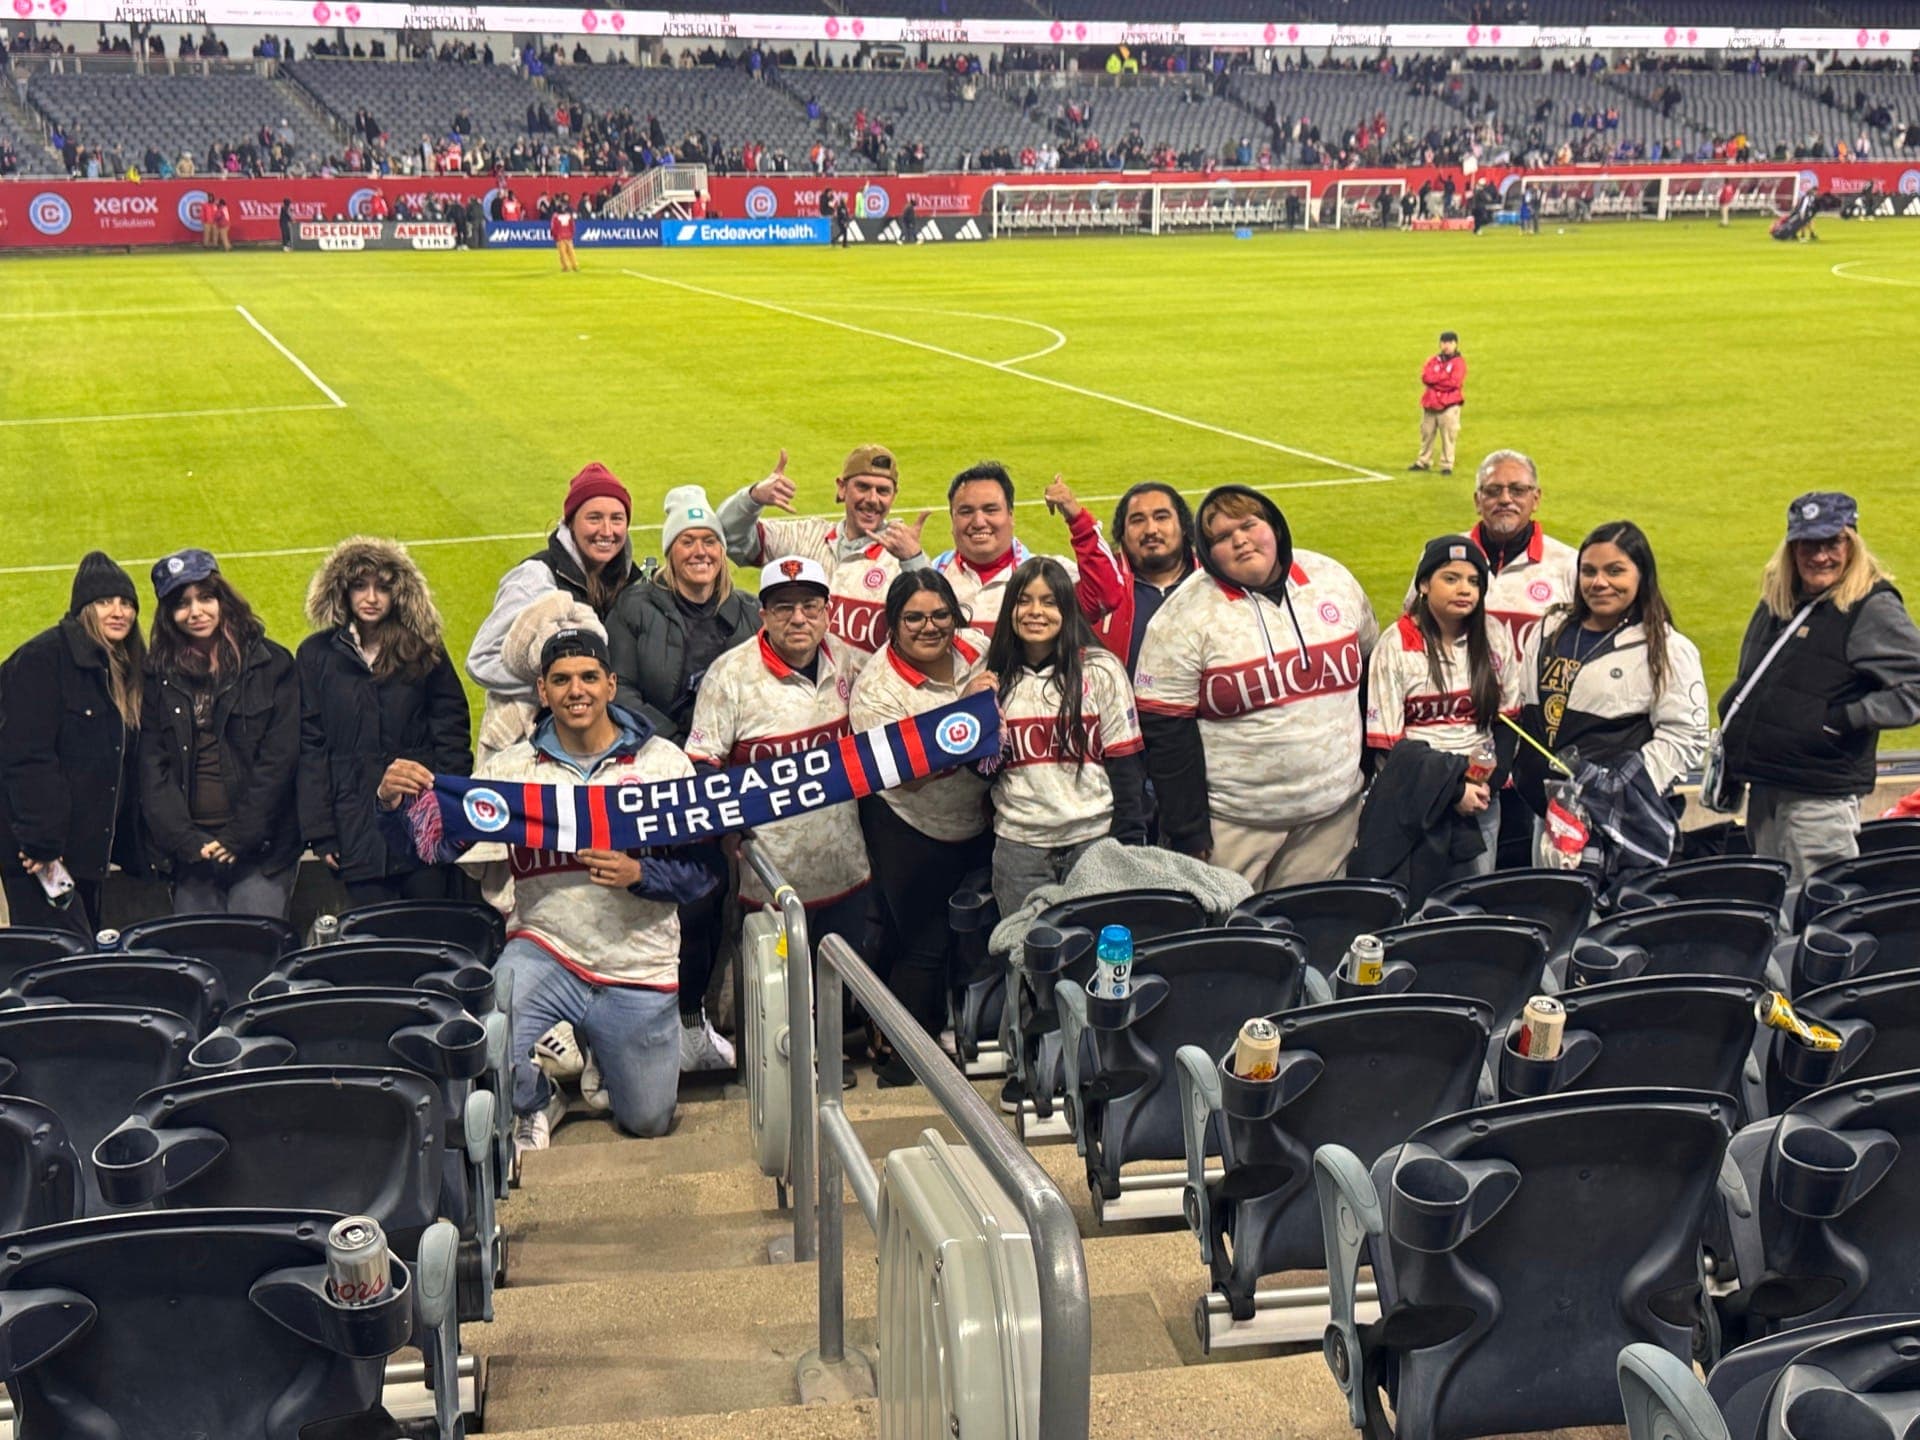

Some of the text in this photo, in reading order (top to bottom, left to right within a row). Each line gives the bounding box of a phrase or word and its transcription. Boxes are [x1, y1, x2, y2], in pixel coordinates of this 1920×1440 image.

[94, 197, 158, 214] xerox
[794, 190, 844, 206] xerx
[239, 200, 326, 216] WINTUST
[112, 217, 155, 228] Solutions
[395, 222, 458, 239] AMERICA
[302, 223, 383, 239] DISCOUNT
[510, 228, 553, 240] MAGELL
[601, 228, 659, 240] MAGELLAN
[701, 224, 767, 240] Endeavor
[327, 239, 358, 248] TIRE
[418, 238, 449, 247] TIRE
[1206, 638, 1362, 718] CHICAG
[617, 749, 831, 813] CHICAGO
[636, 781, 826, 841] FIRE FC
